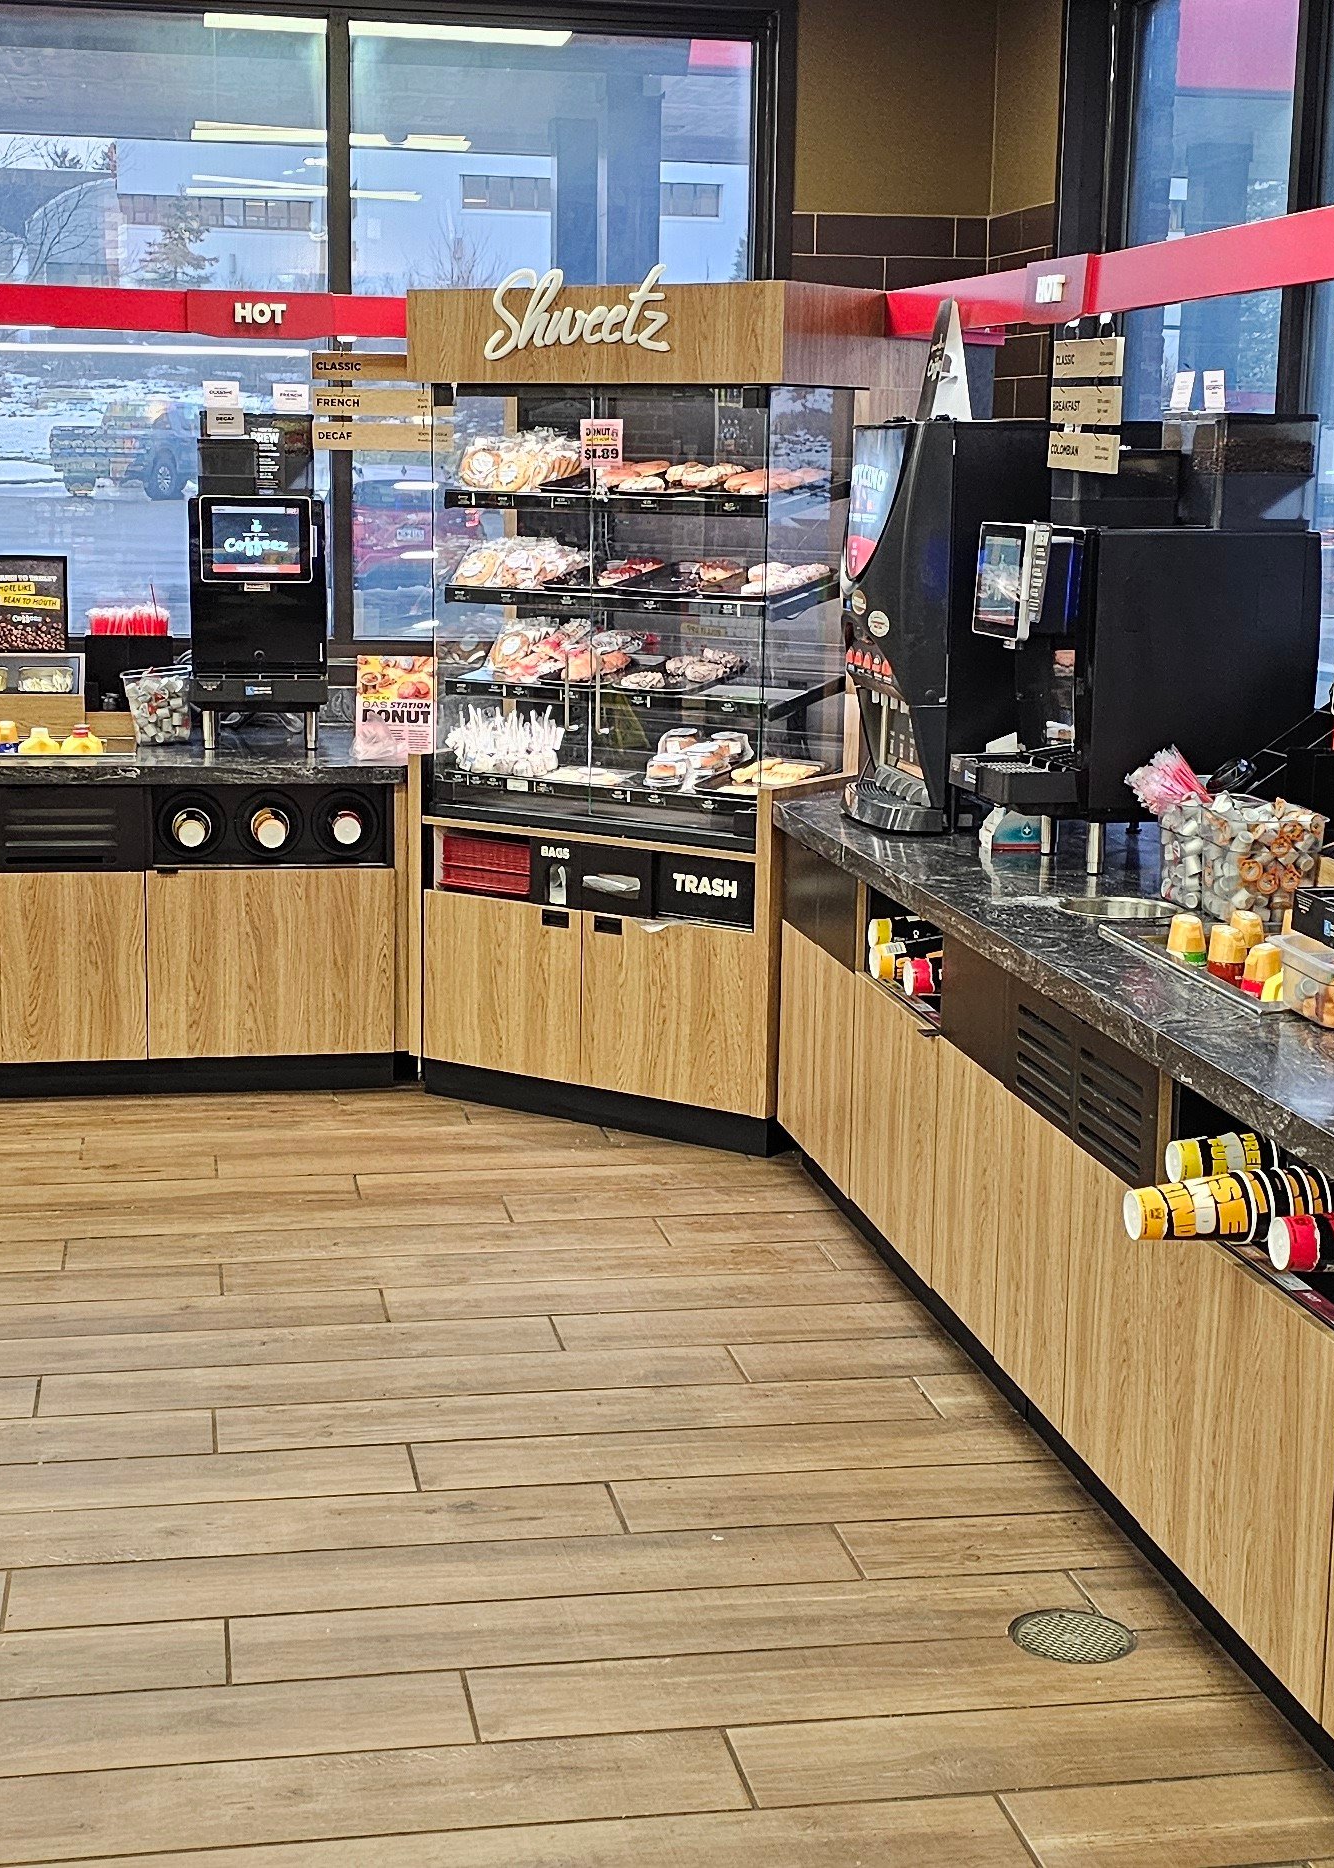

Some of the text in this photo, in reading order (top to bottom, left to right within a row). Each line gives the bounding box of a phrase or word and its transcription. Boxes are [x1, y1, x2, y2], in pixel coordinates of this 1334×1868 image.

[1035, 274, 1066, 303] HOT
[234, 302, 286, 325] HOT
[484, 263, 671, 361] Shweetz
[1055, 354, 1075, 365] CLASSIC
[316, 361, 362, 372] CLASSIC
[317, 398, 360, 408] FRENCH
[1052, 400, 1080, 411] BREAKFAST
[318, 432, 352, 441] DECAF
[584, 449, 619, 460] $1.89
[1050, 443, 1079, 456] COLOMBIAN
[3, 597, 57, 606] BEAN TO MOUTH
[541, 845, 570, 859] BAGS
[673, 873, 738, 899] TRASH
